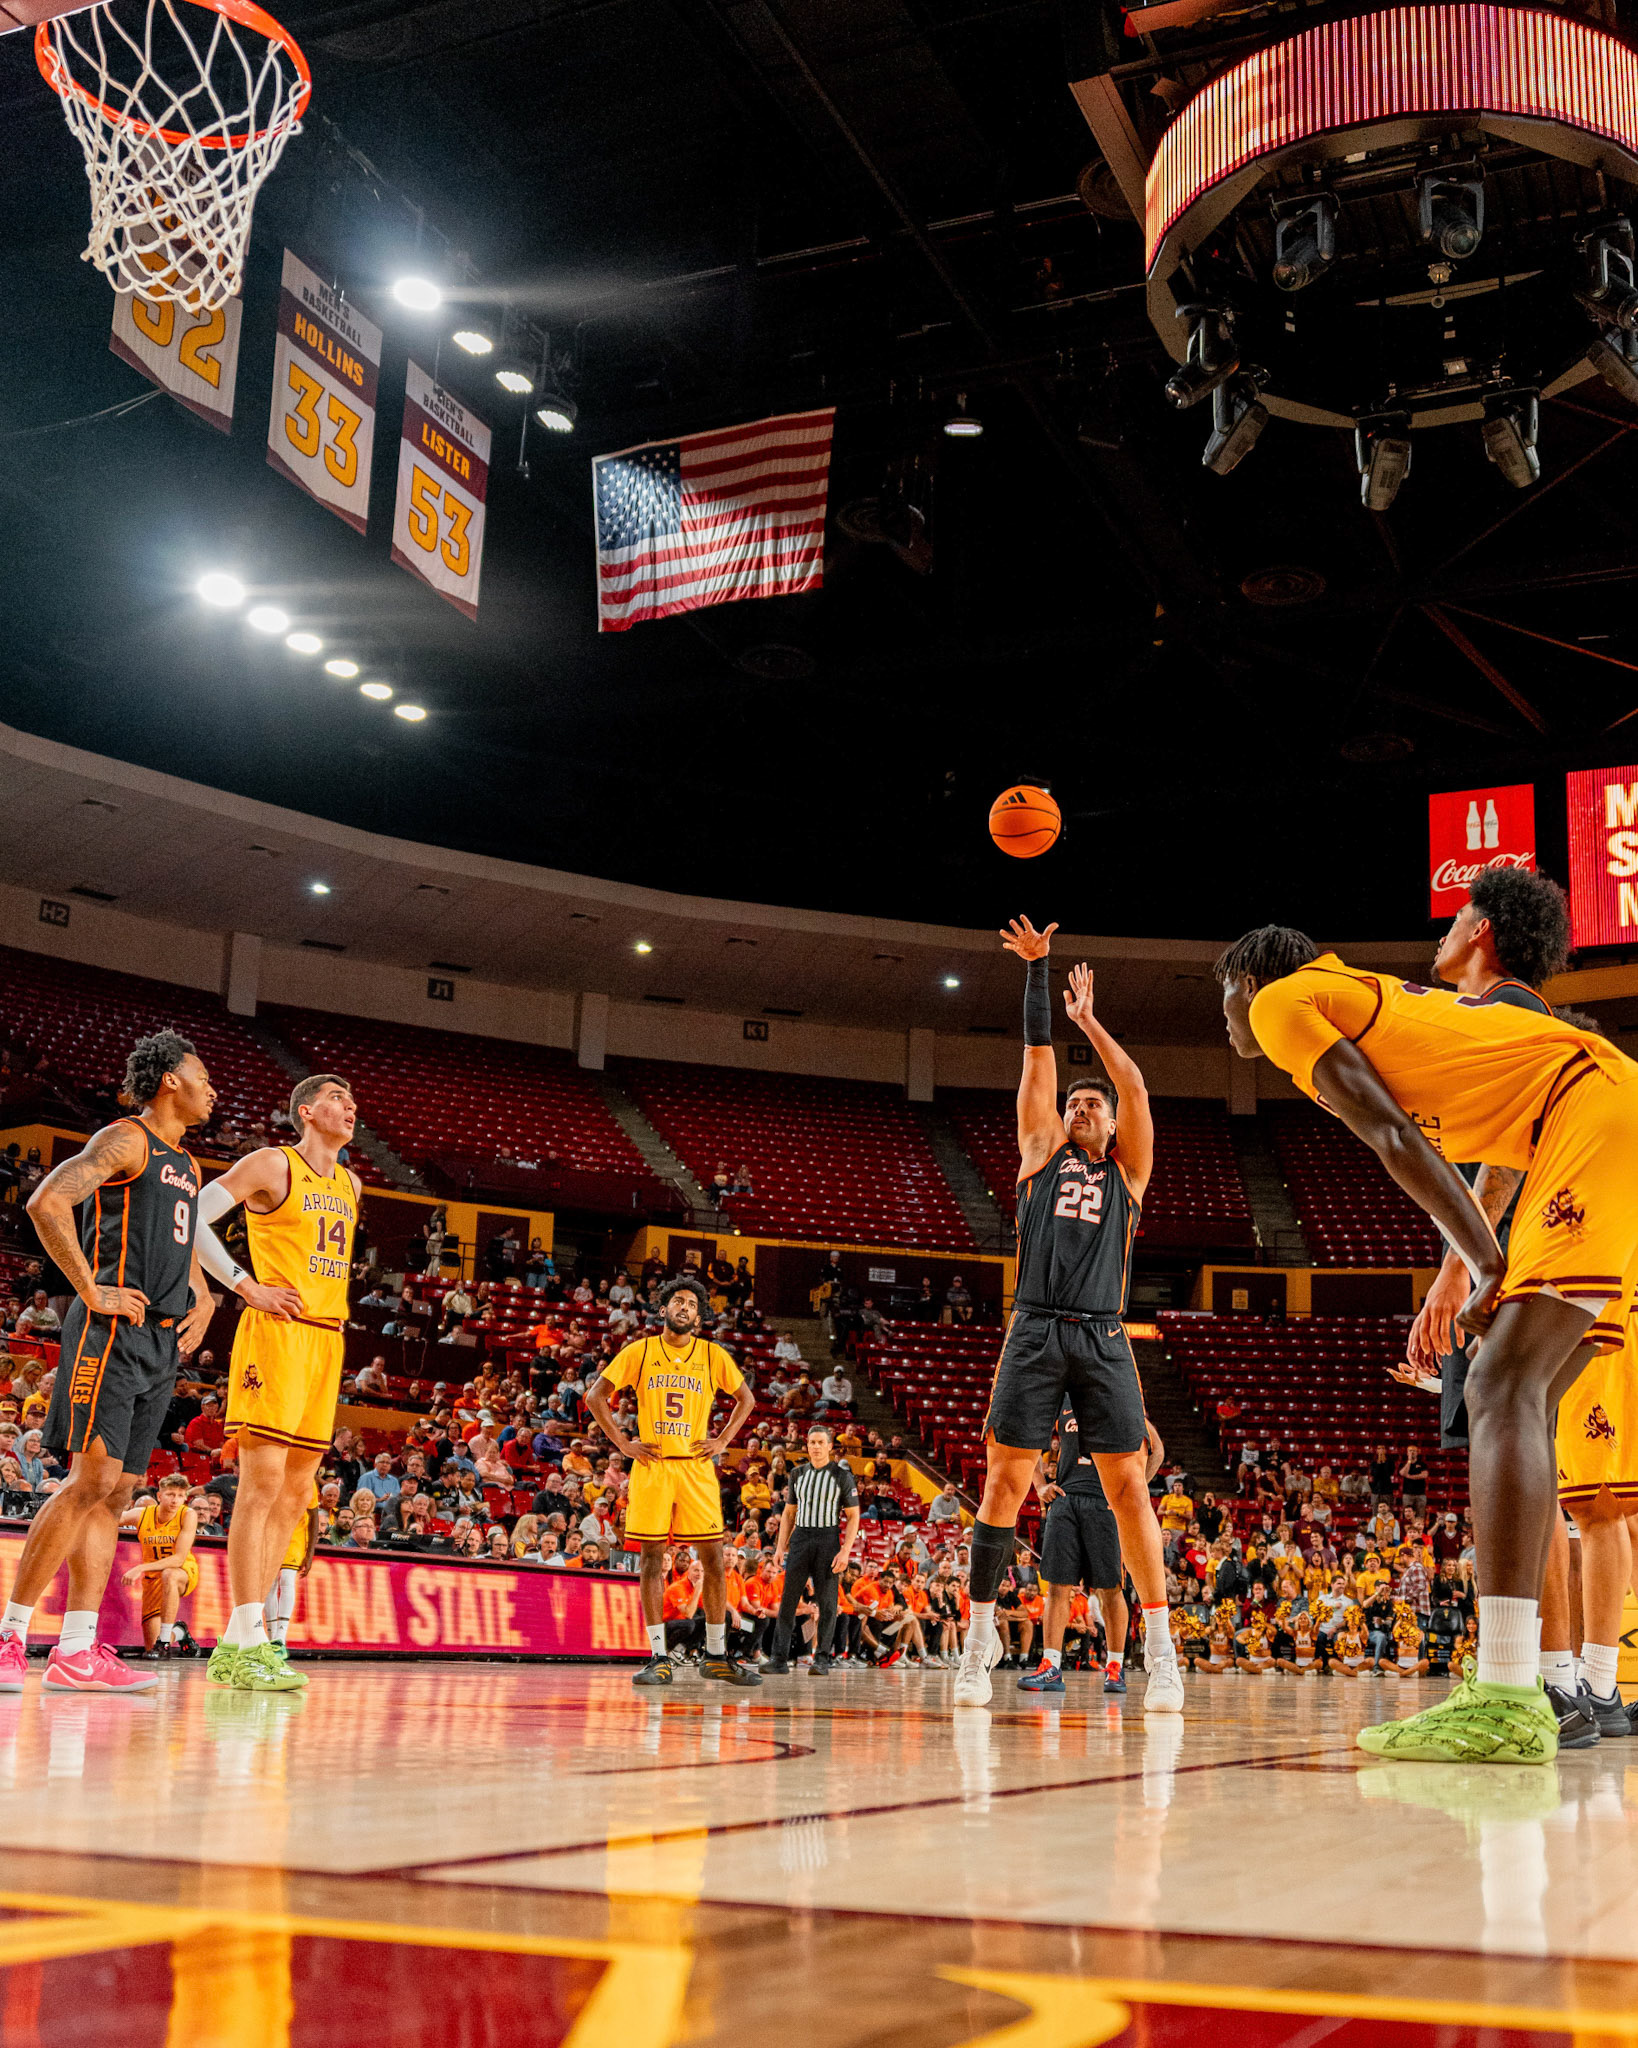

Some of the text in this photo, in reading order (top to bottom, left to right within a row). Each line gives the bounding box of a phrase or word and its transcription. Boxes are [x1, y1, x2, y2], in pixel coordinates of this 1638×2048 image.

[302, 286, 363, 349] BASKETBALL
[318, 283, 351, 321] MEN'S
[293, 311, 365, 388] HOLLINS
[284, 359, 363, 488] 33
[422, 392, 475, 449] BASKETBALL
[421, 421, 471, 481] LISTER
[408, 463, 474, 577] 53
[41, 902, 68, 923] H2
[432, 982, 449, 998] J1
[173, 1199, 190, 1245] 9
[302, 1193, 355, 1222] ARIZONA
[1054, 1181, 1104, 1225] 22
[316, 1215, 347, 1256] 14
[73, 1355, 101, 1405] POKES
[647, 1374, 703, 1395] ARIZONA
[665, 1392, 685, 1419] 5
[655, 1421, 691, 1438] STATE
[153, 1546, 173, 1560] 15
[406, 1566, 530, 1647] STATE
